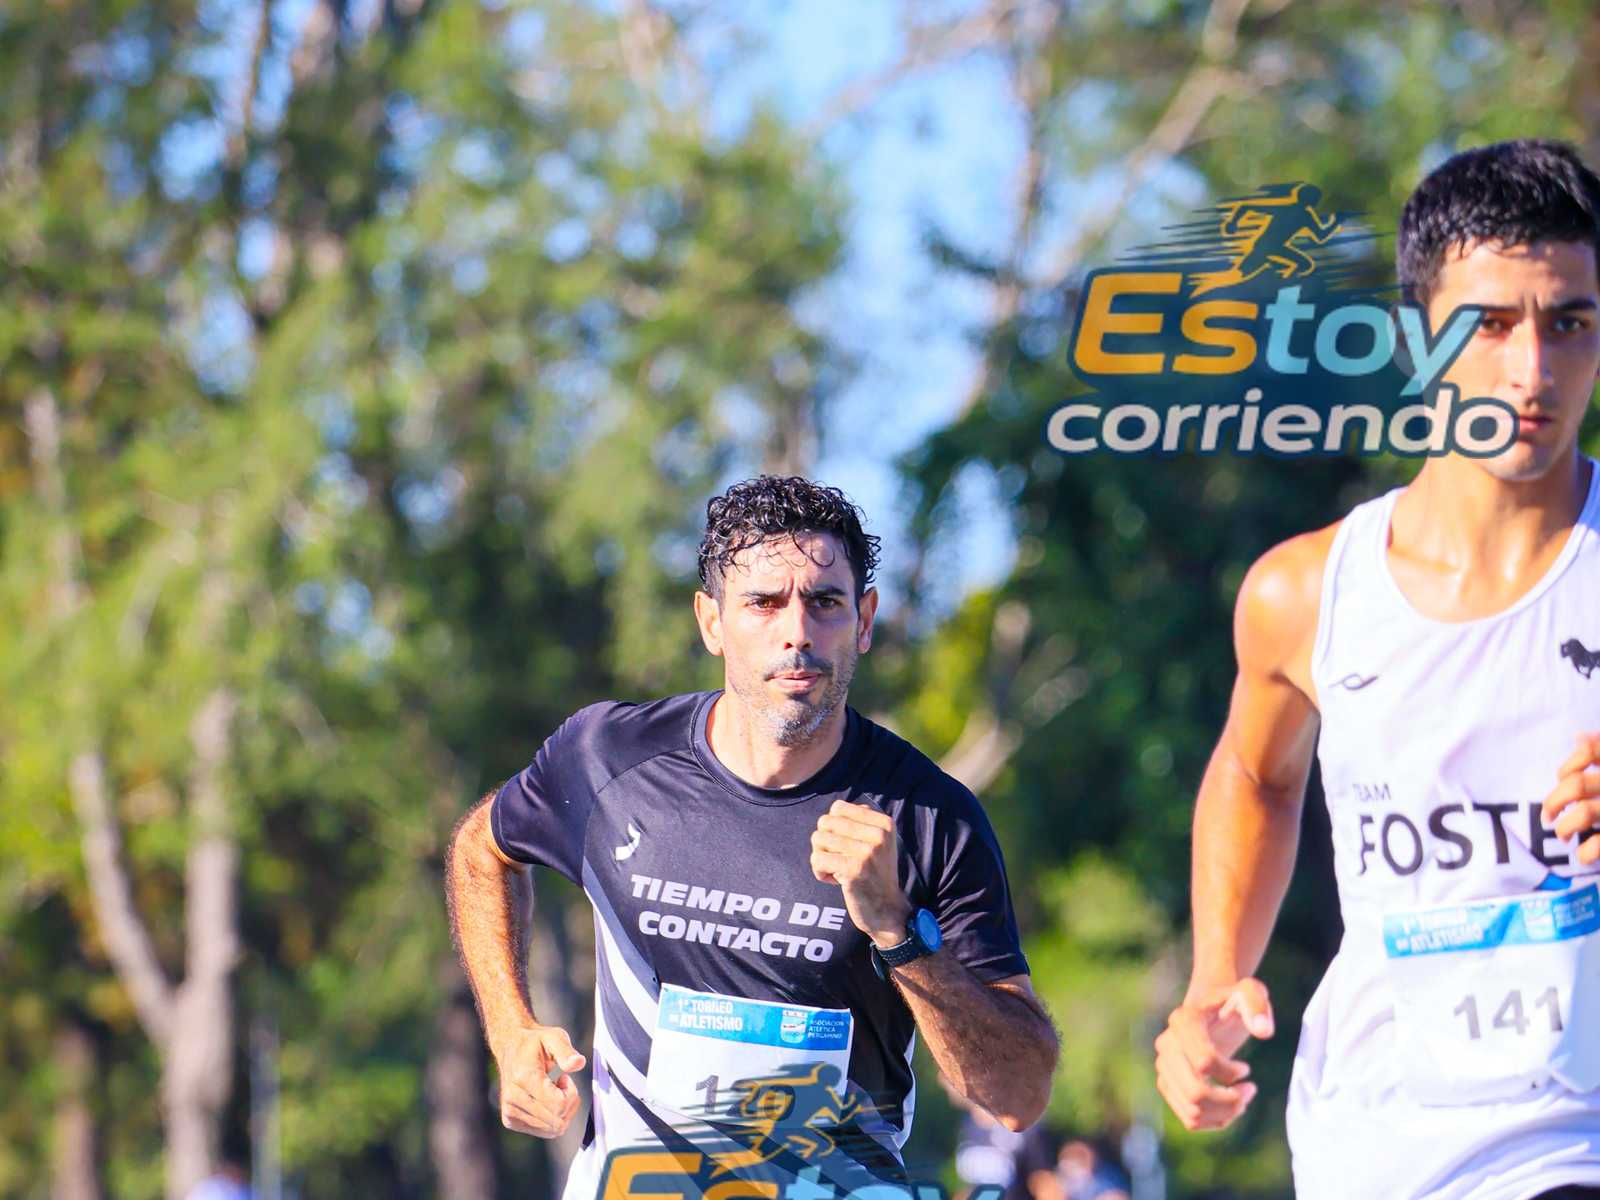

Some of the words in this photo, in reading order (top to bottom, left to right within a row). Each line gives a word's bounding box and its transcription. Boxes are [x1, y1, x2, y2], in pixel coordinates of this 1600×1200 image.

[1357, 803, 1600, 876] FOSTE
[631, 874, 782, 921] TIEMPO
[788, 902, 846, 931] DE
[638, 911, 834, 962] CONTACTO
[680, 1014, 743, 1031] ATLETISMO
[1453, 986, 1564, 1041] 141
